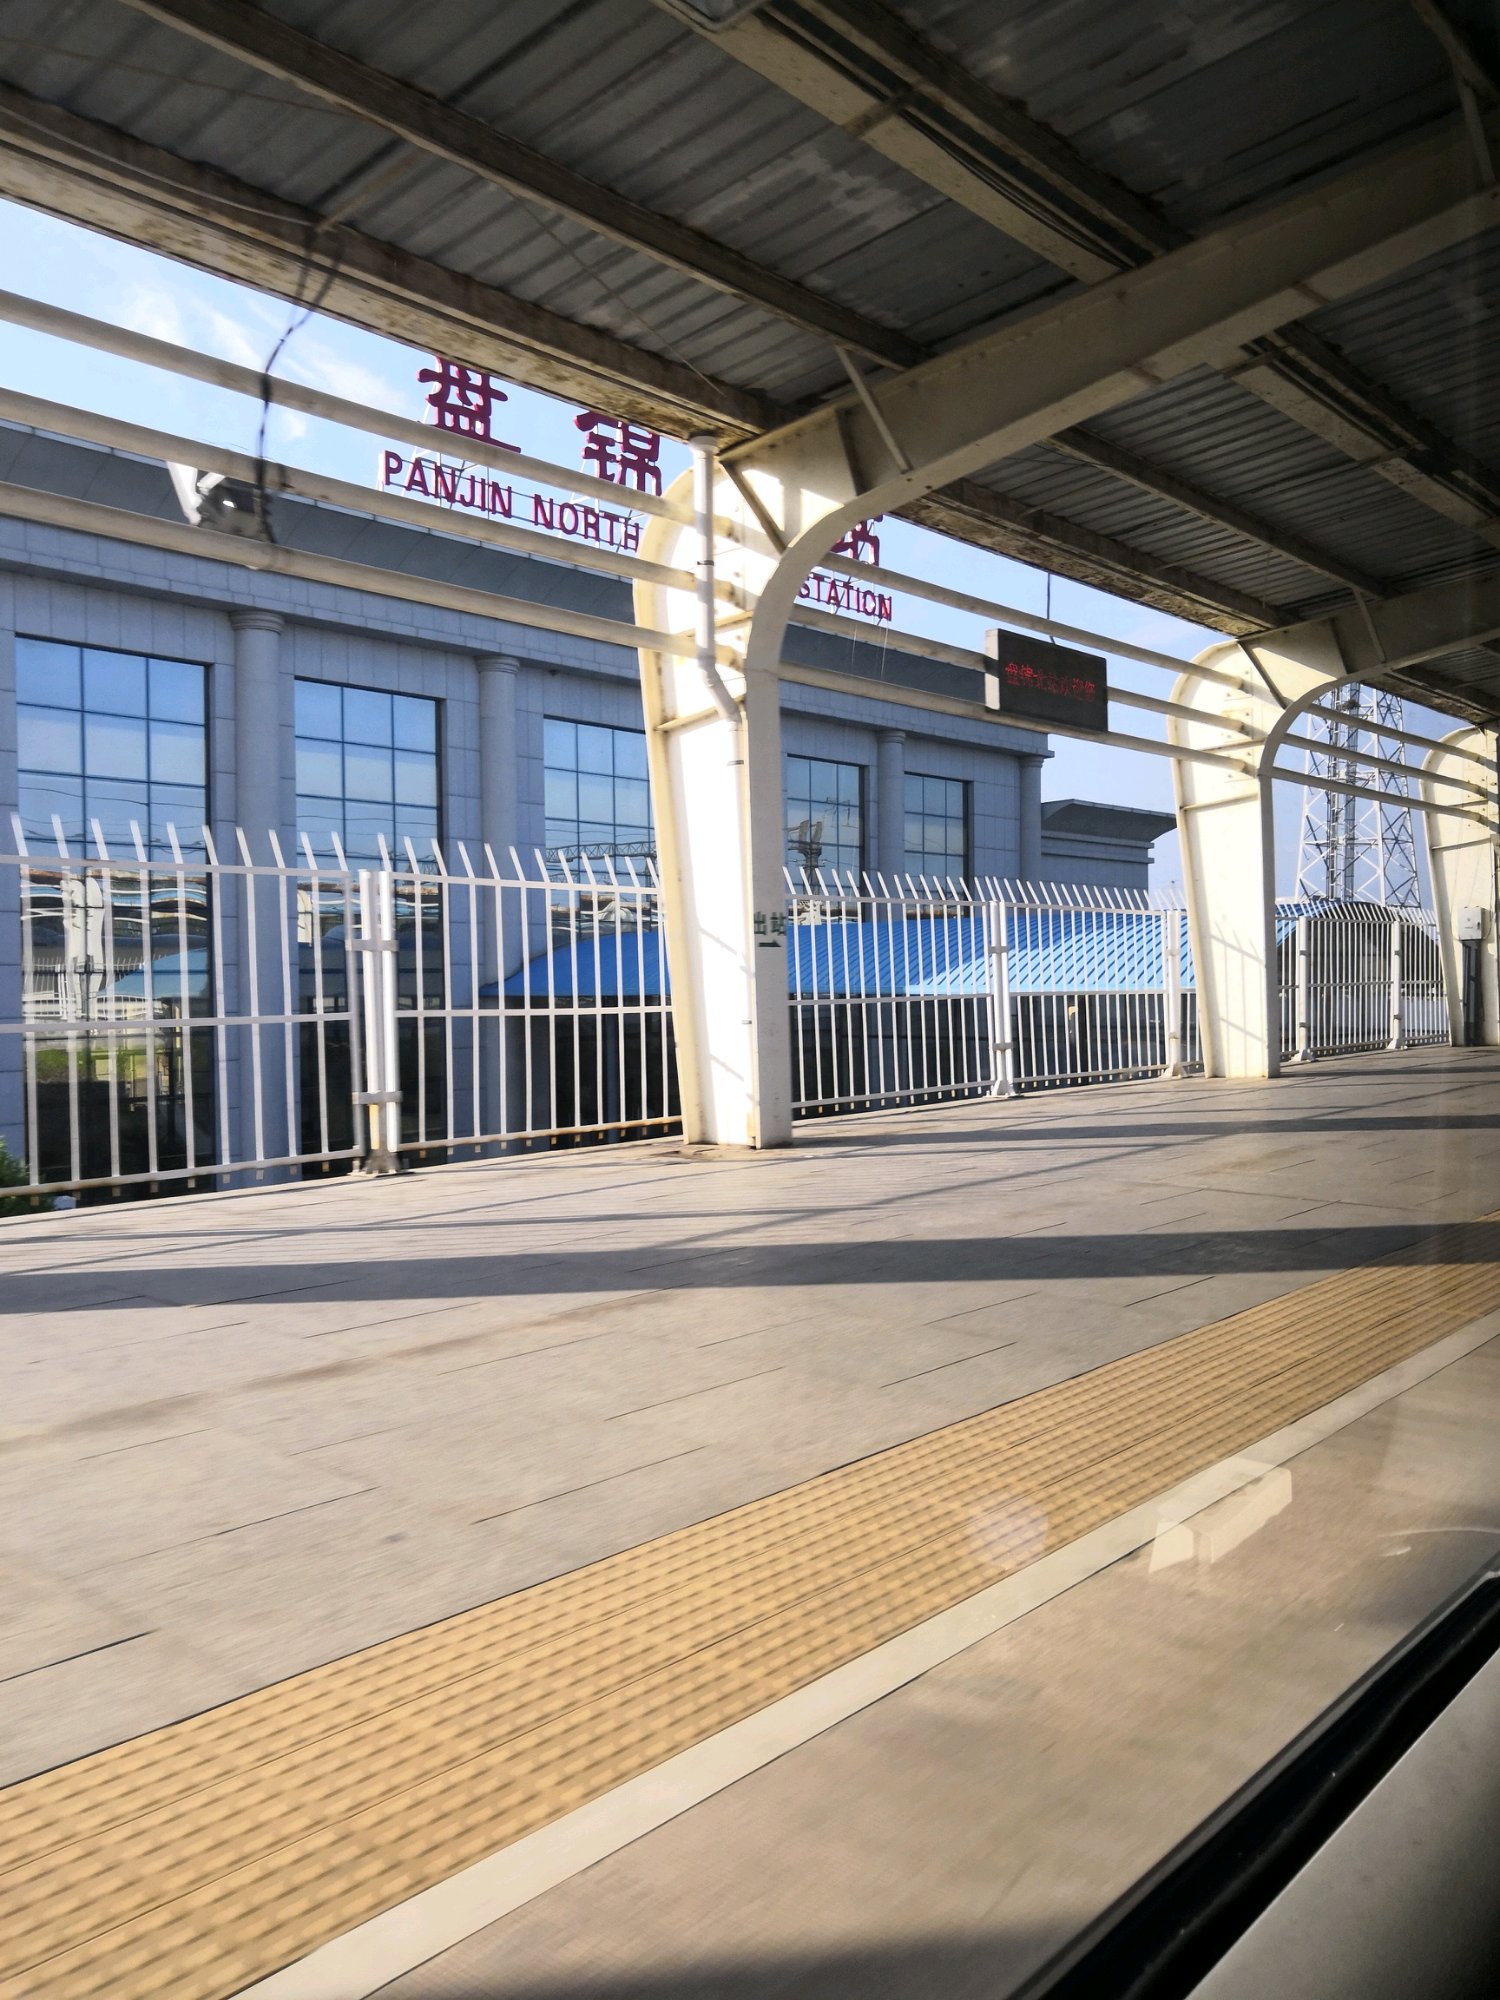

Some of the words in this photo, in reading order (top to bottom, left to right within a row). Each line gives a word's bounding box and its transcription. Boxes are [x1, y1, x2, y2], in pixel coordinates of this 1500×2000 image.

[382, 450, 513, 519] PANJIN
[532, 493, 640, 552] NORTH
[753, 911, 787, 937] 出站
